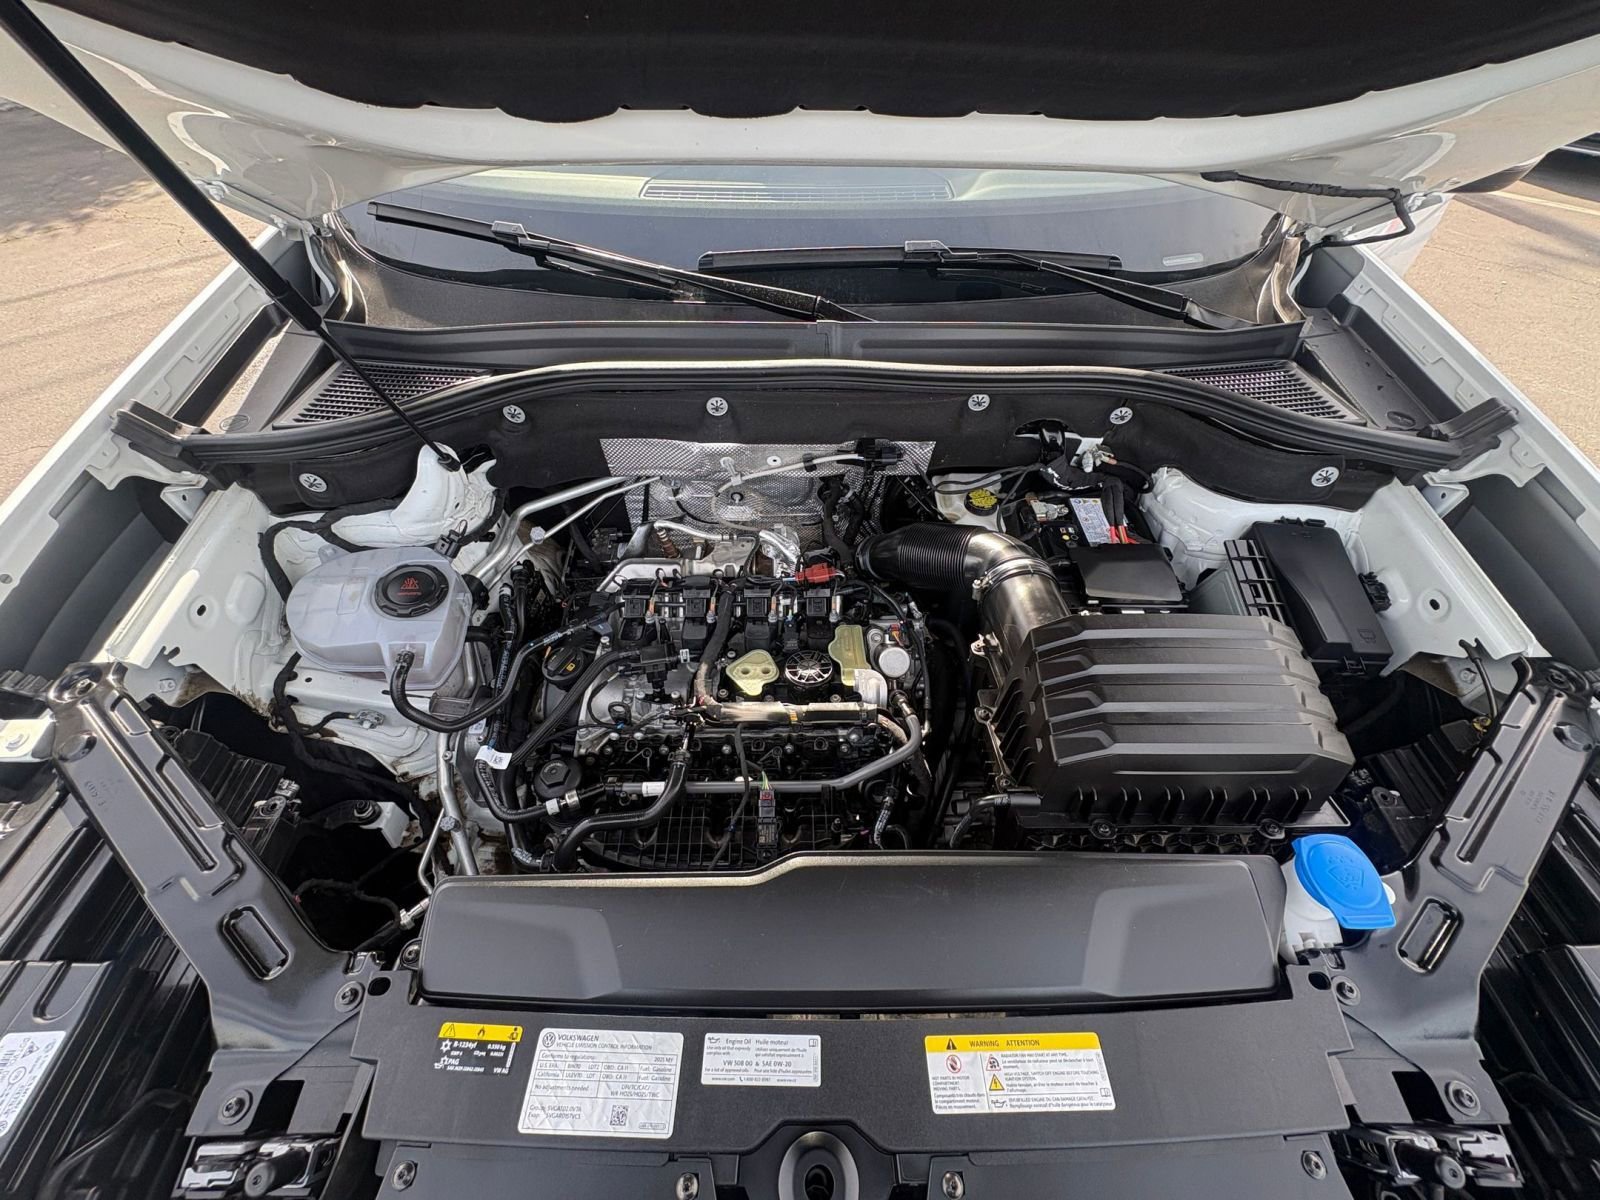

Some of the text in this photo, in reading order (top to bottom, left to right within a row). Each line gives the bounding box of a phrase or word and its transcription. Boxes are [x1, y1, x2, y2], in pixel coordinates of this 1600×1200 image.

[557, 1034, 600, 1042] VOLKSWAGEN
[726, 1038, 743, 1046] Engine
[453, 1041, 478, 1050] R-1234yf
[969, 1039, 1040, 1047] WARNING ATTENTION
[773, 1060, 792, 1068] 0W-20
